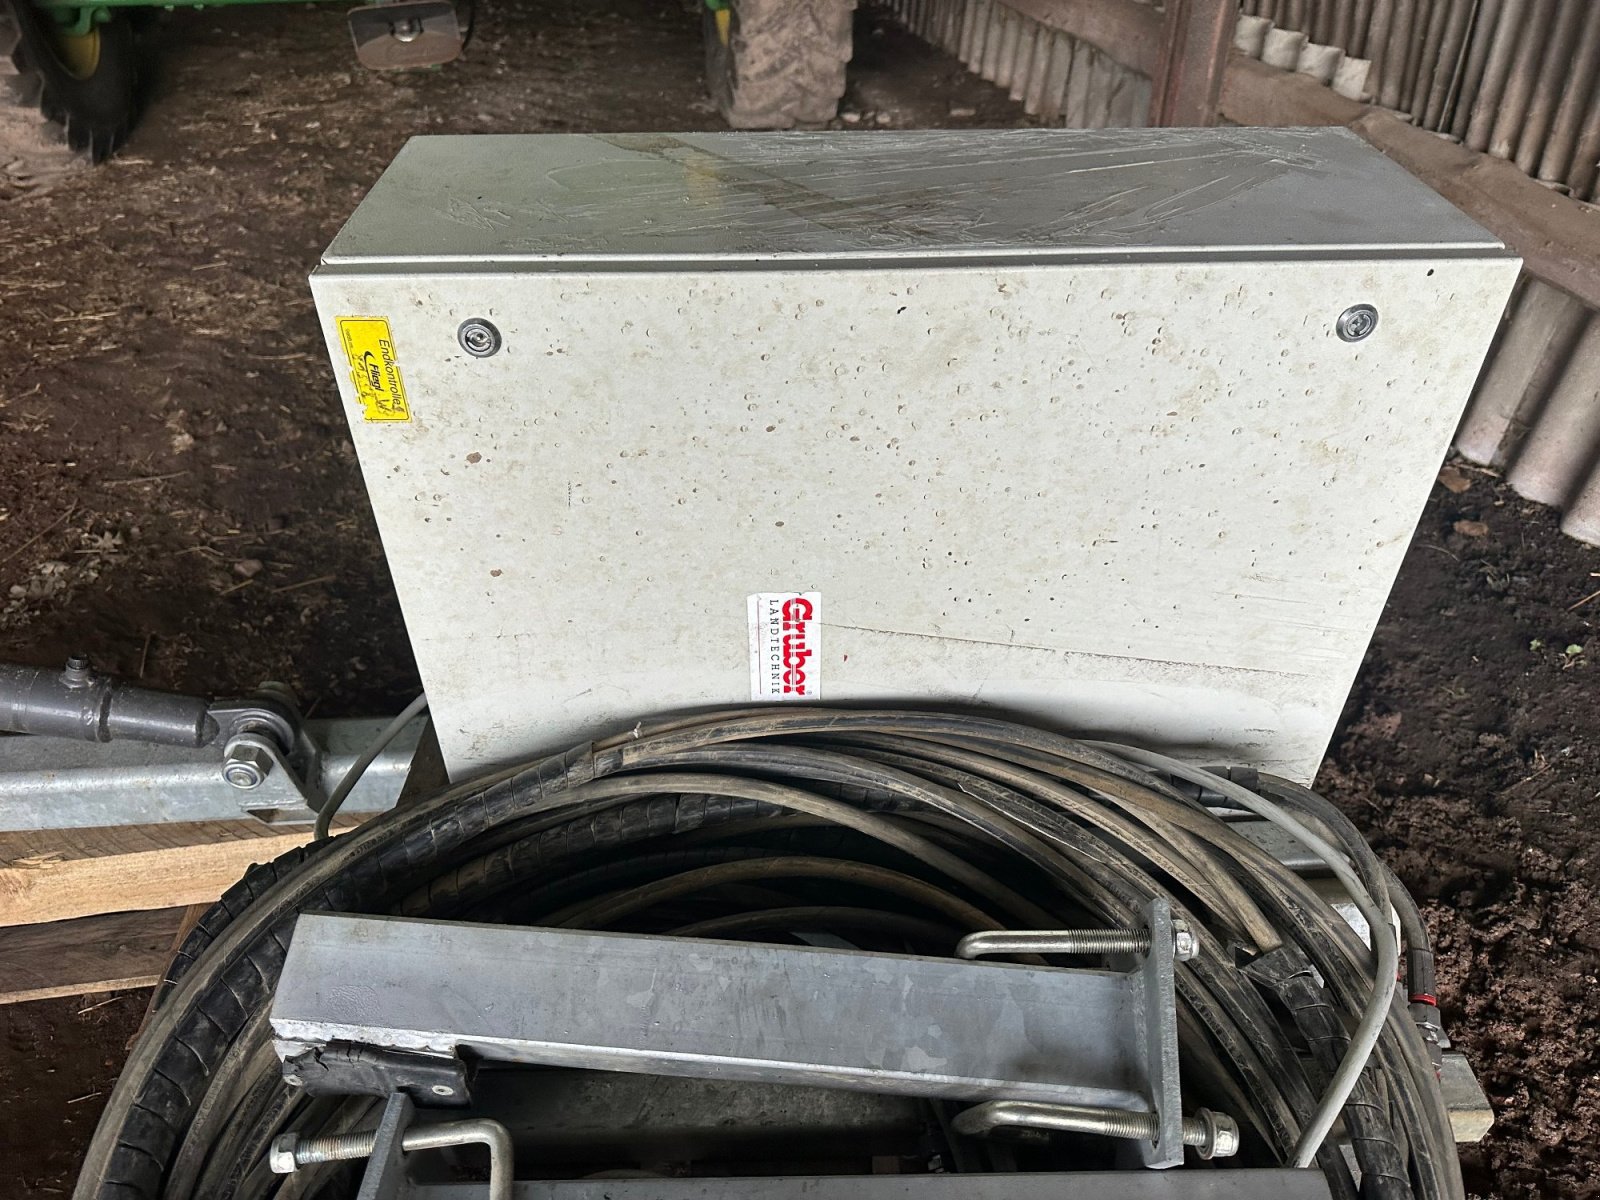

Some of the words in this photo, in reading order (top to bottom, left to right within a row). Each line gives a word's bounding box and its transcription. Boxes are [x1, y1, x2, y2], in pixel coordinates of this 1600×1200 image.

[379, 339, 402, 405] Endkontrolle
[769, 599, 780, 694] LANDTECHNIK
[782, 598, 813, 695] Gruber
